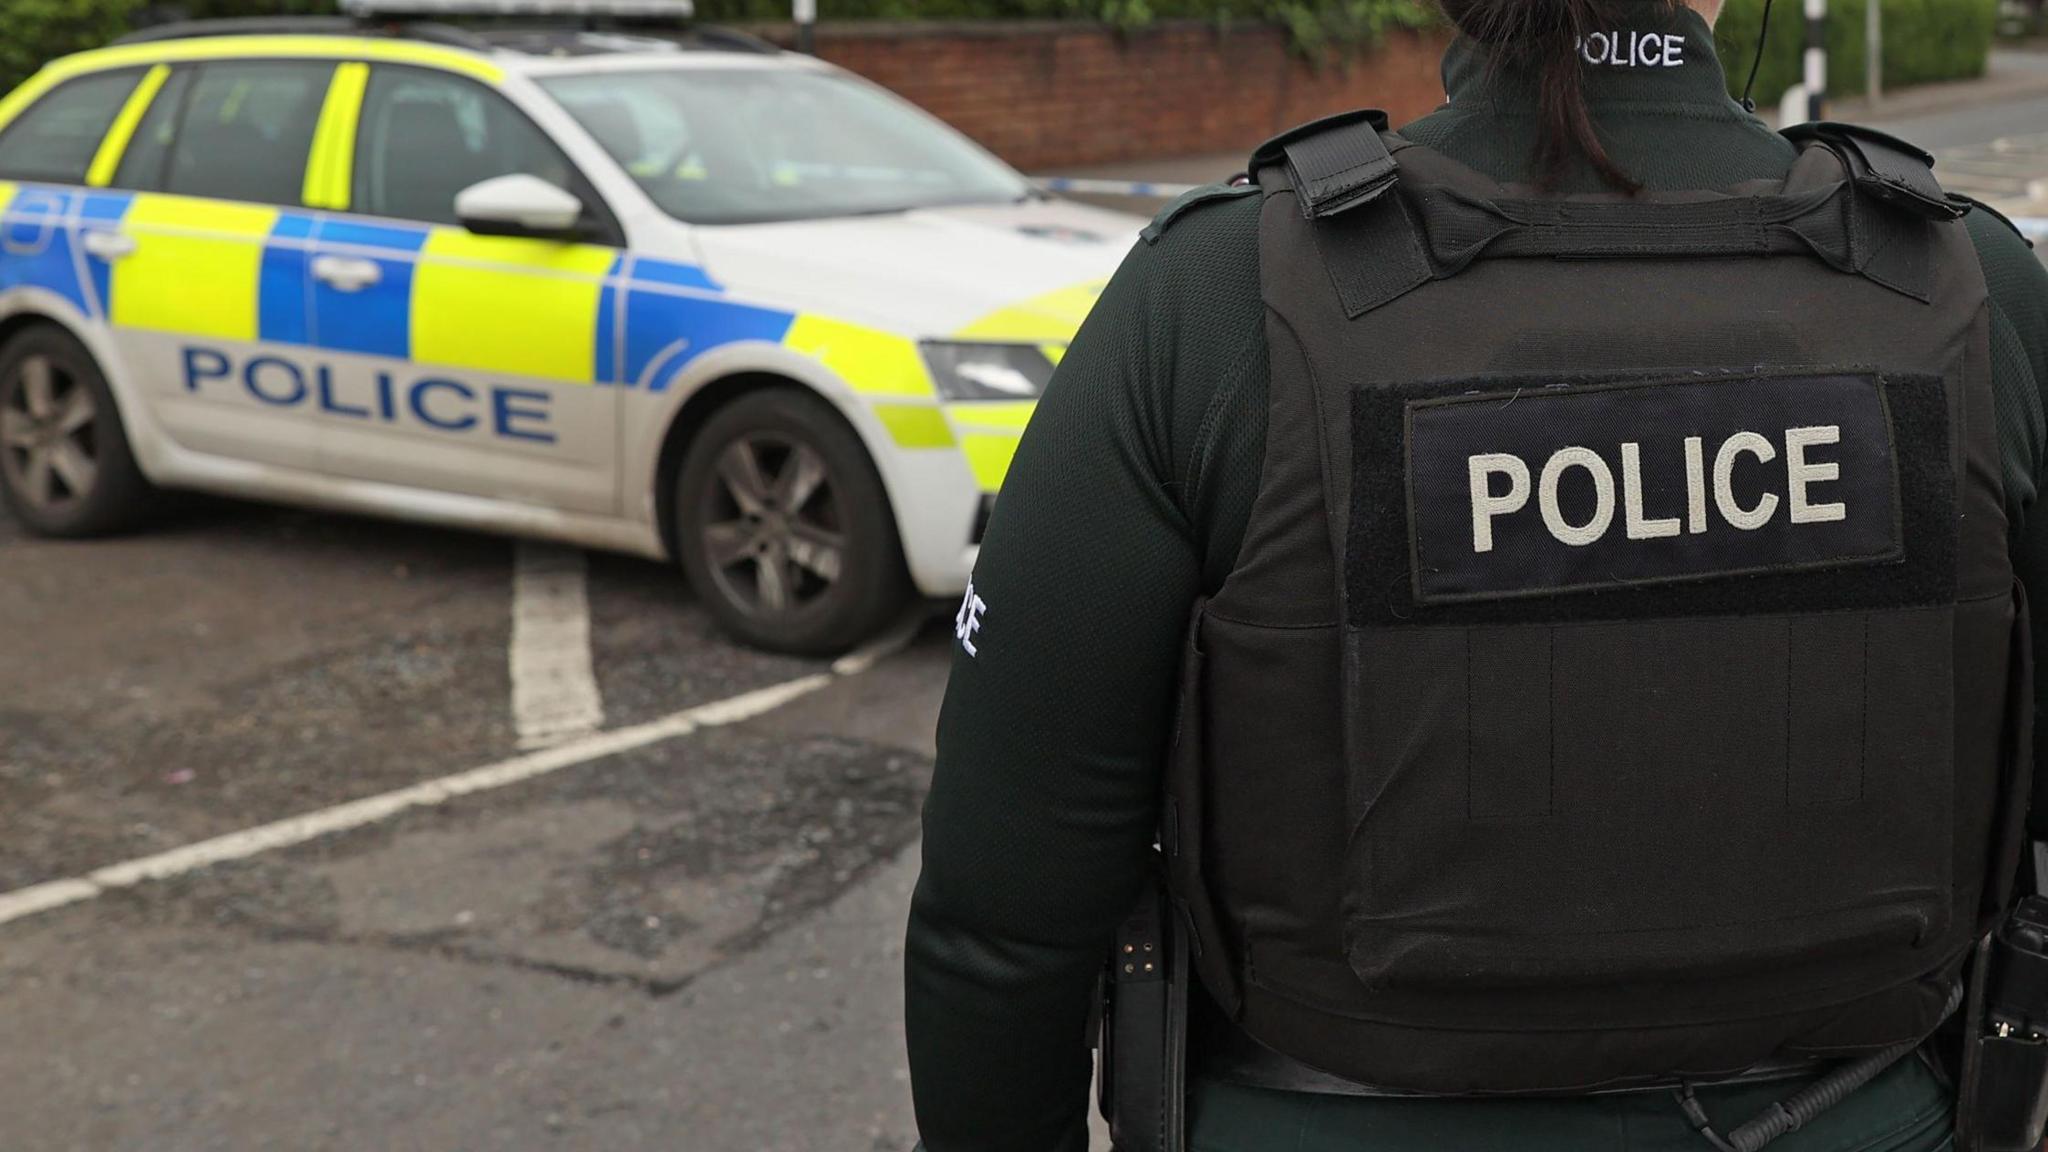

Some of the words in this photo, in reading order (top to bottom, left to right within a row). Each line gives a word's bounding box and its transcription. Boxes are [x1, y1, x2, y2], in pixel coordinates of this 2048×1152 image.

[1575, 31, 1685, 67] OLICE
[181, 345, 558, 444] POLICE
[1468, 425, 1846, 553] POLICE
